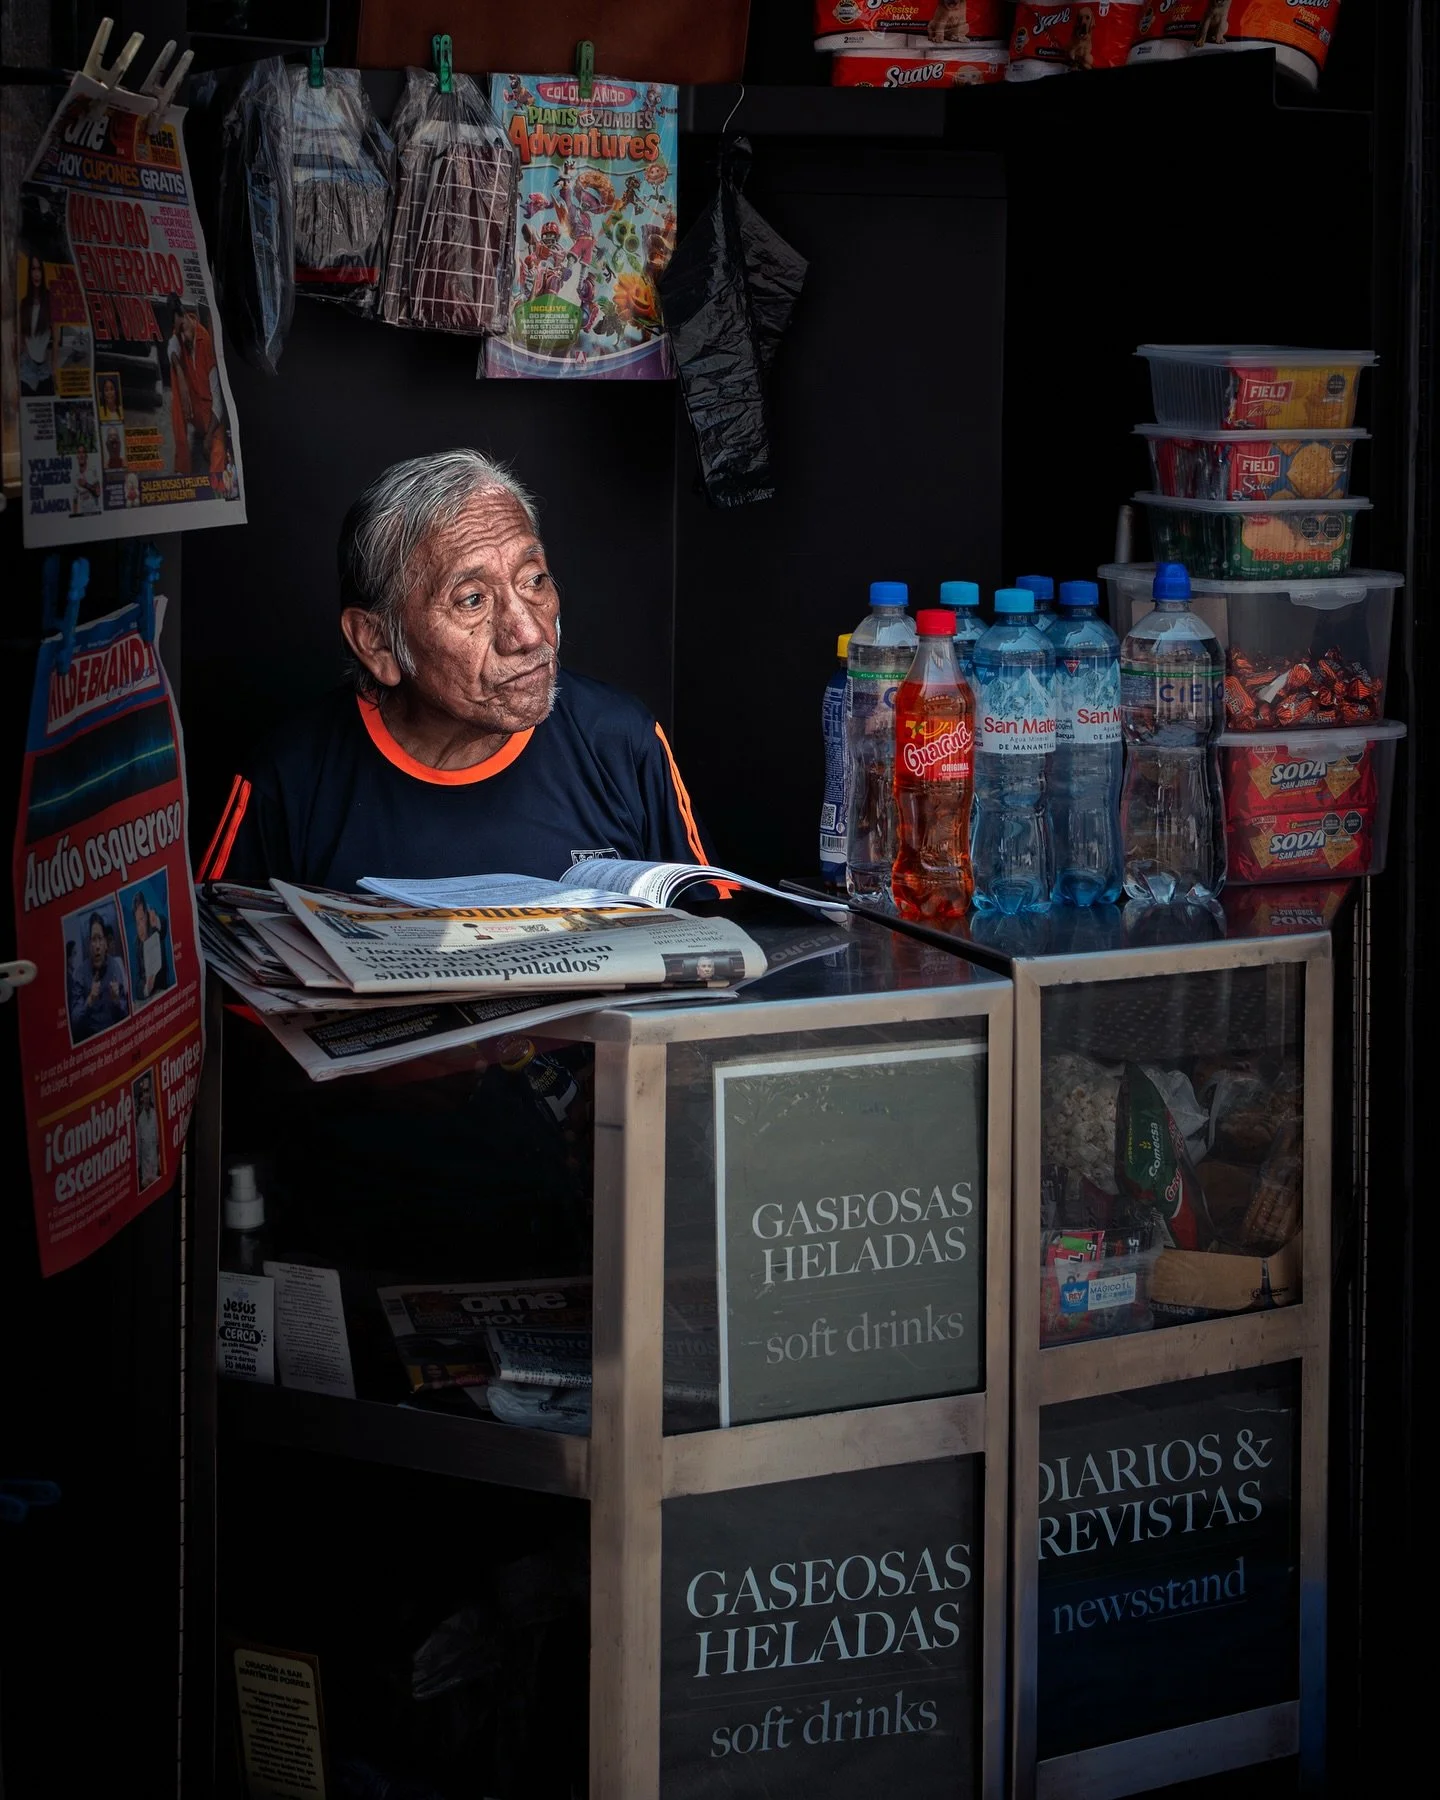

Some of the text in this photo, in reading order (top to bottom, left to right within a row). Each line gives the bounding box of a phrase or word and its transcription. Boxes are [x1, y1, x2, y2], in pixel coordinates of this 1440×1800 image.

[892, 13, 912, 21] MAX
[883, 61, 945, 88] Suave
[529, 107, 578, 126] PLANTS
[594, 109, 654, 129] ZOMBIES
[508, 114, 661, 165] Adventures
[57, 152, 186, 195] HOY CUPONES GRATIS
[69, 192, 150, 248] MADURO
[74, 245, 184, 297] ENTERRADO
[87, 291, 120, 340] EN
[116, 294, 164, 342] VIDA
[1249, 384, 1286, 399] FIELD
[1242, 459, 1276, 472] FIELD
[1253, 547, 1332, 565] Margarita
[984, 717, 1056, 734] San Mate
[1077, 708, 1110, 724] San
[941, 762, 969, 773] ORIGINAL
[1271, 761, 1327, 783] SODA
[1281, 779, 1318, 790] SAN JORGE
[84, 800, 182, 883] asqueroso
[1270, 829, 1325, 853] SODA
[1279, 848, 1316, 860] SAN JORGE
[374, 970, 430, 981] sido
[45, 1100, 115, 1174] ¡Cambio
[116, 1088, 132, 1127] de
[1149, 1121, 1161, 1178] Comecsa
[55, 1122, 132, 1203] escenario!
[752, 1182, 973, 1240] GASEOSAS
[762, 1226, 967, 1285] HELADAS
[223, 1298, 257, 1315] Jesús
[1068, 1292, 1083, 1301] REY
[240, 1313, 257, 1322] cruz
[471, 1314, 526, 1327] HOY
[225, 1328, 257, 1343] CERCA
[766, 1303, 965, 1365] soft drinks
[235, 1363, 257, 1373] MANO
[1233, 1428, 1273, 1471] &
[1038, 1480, 1264, 1560] REVISTAS
[686, 1543, 972, 1619] GASEOSAS
[1052, 1556, 1246, 1634] newsstand
[692, 1602, 961, 1678] HELADAS
[245, 1661, 279, 1674] ORACIÓN
[287, 1670, 302, 1679] SAN
[268, 1674, 279, 1682] DE
[710, 1690, 938, 1758] soft drinks
